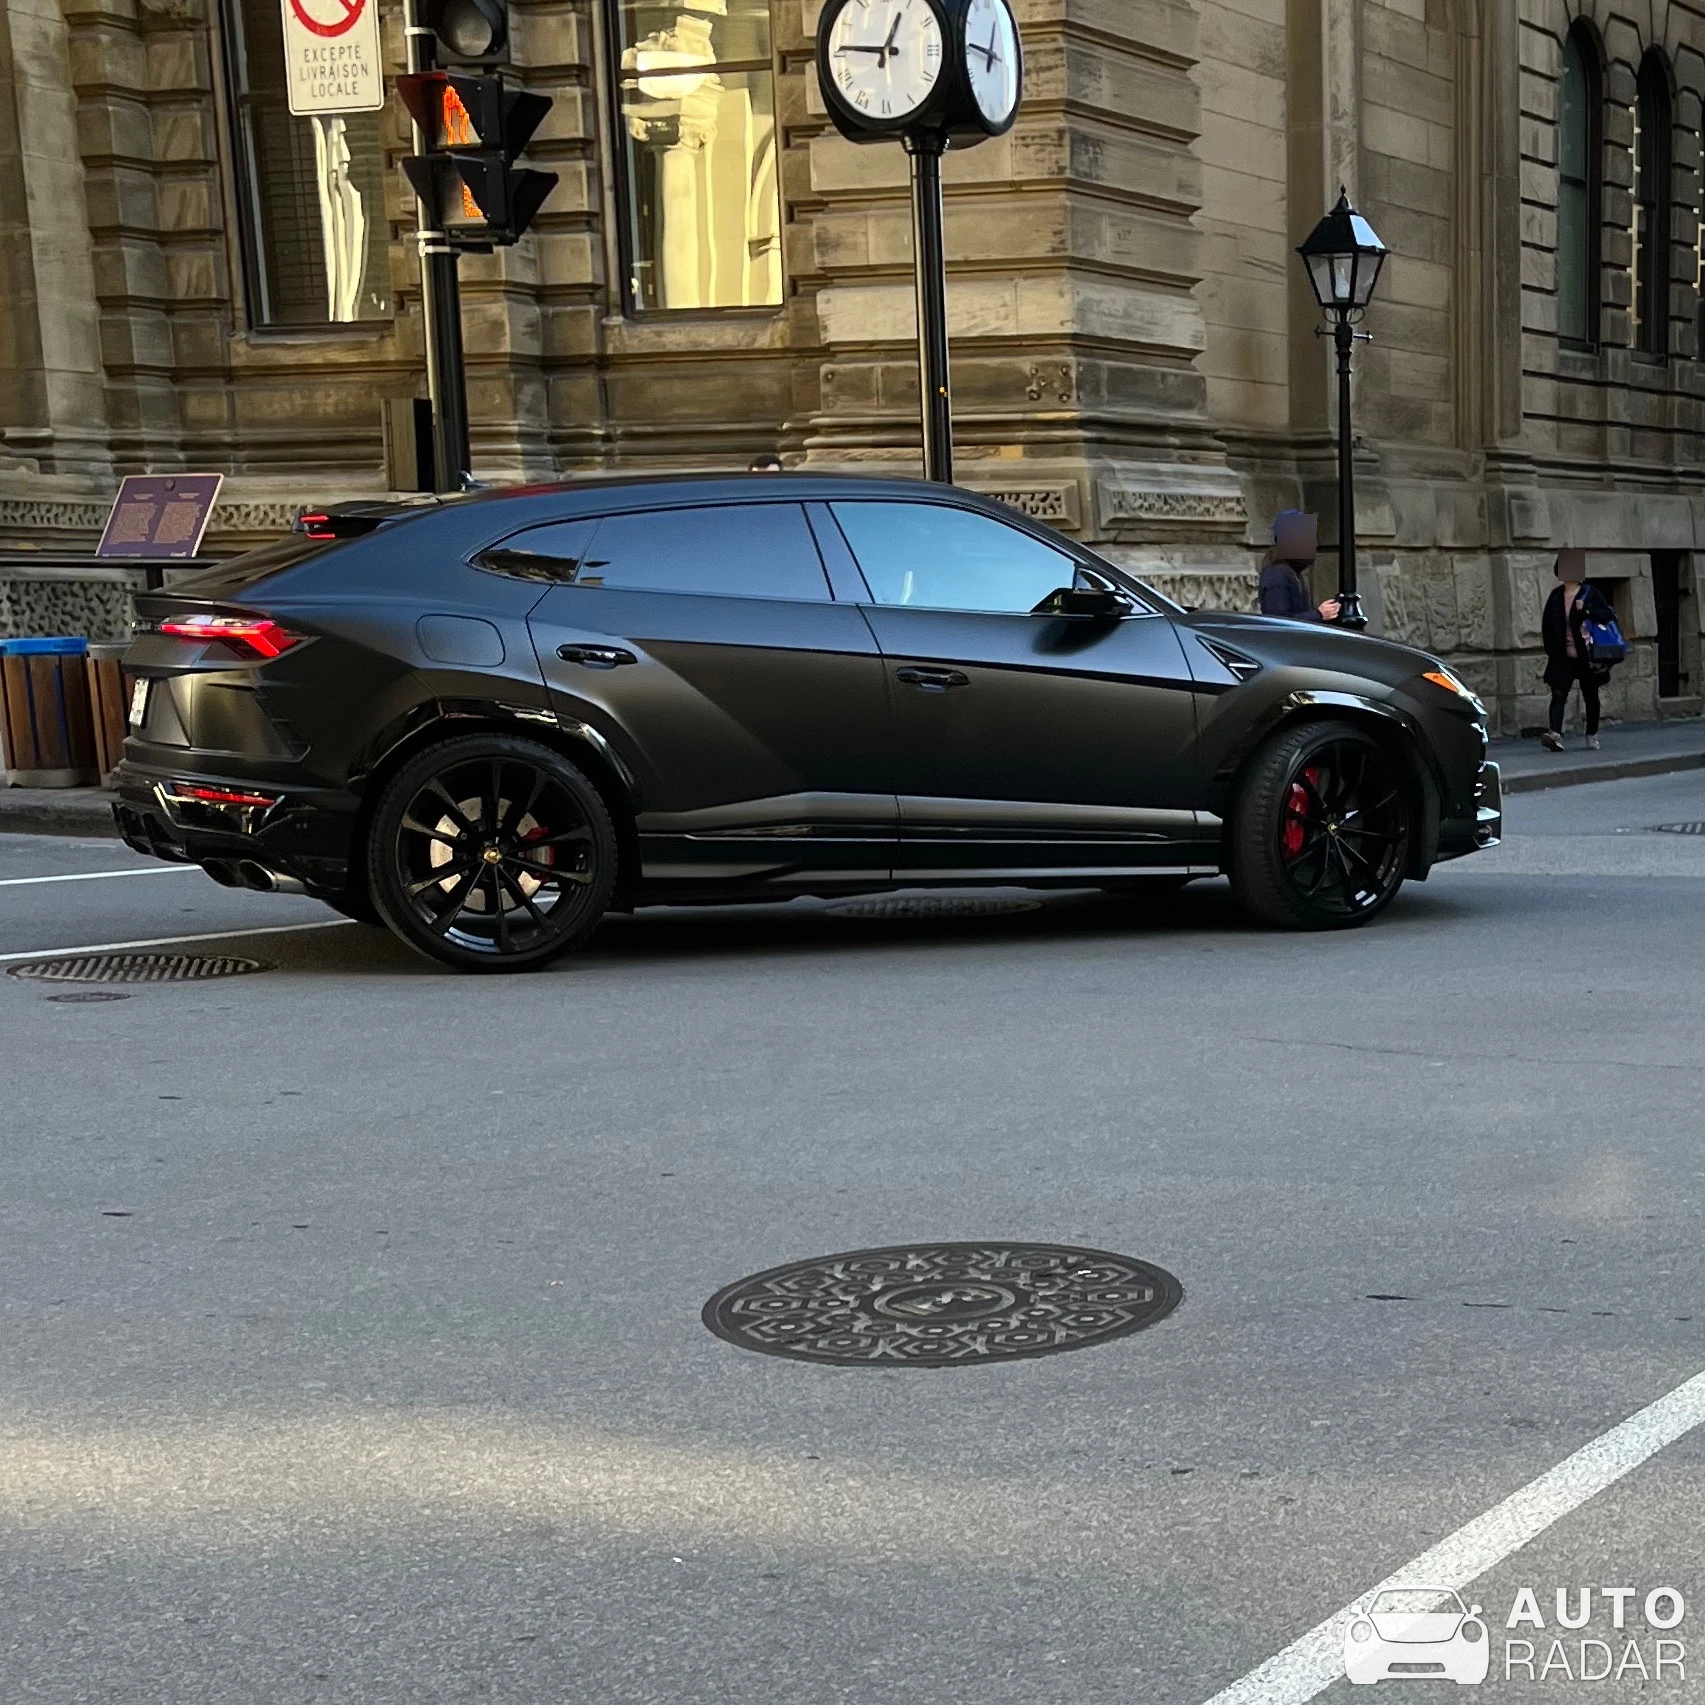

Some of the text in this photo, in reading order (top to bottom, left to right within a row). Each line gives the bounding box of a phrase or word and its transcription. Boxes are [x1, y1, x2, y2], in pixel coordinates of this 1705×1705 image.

[303, 41, 362, 63] EXCEPTÉ
[299, 62, 369, 82] LIVRAISON
[310, 80, 359, 98] LOCALE
